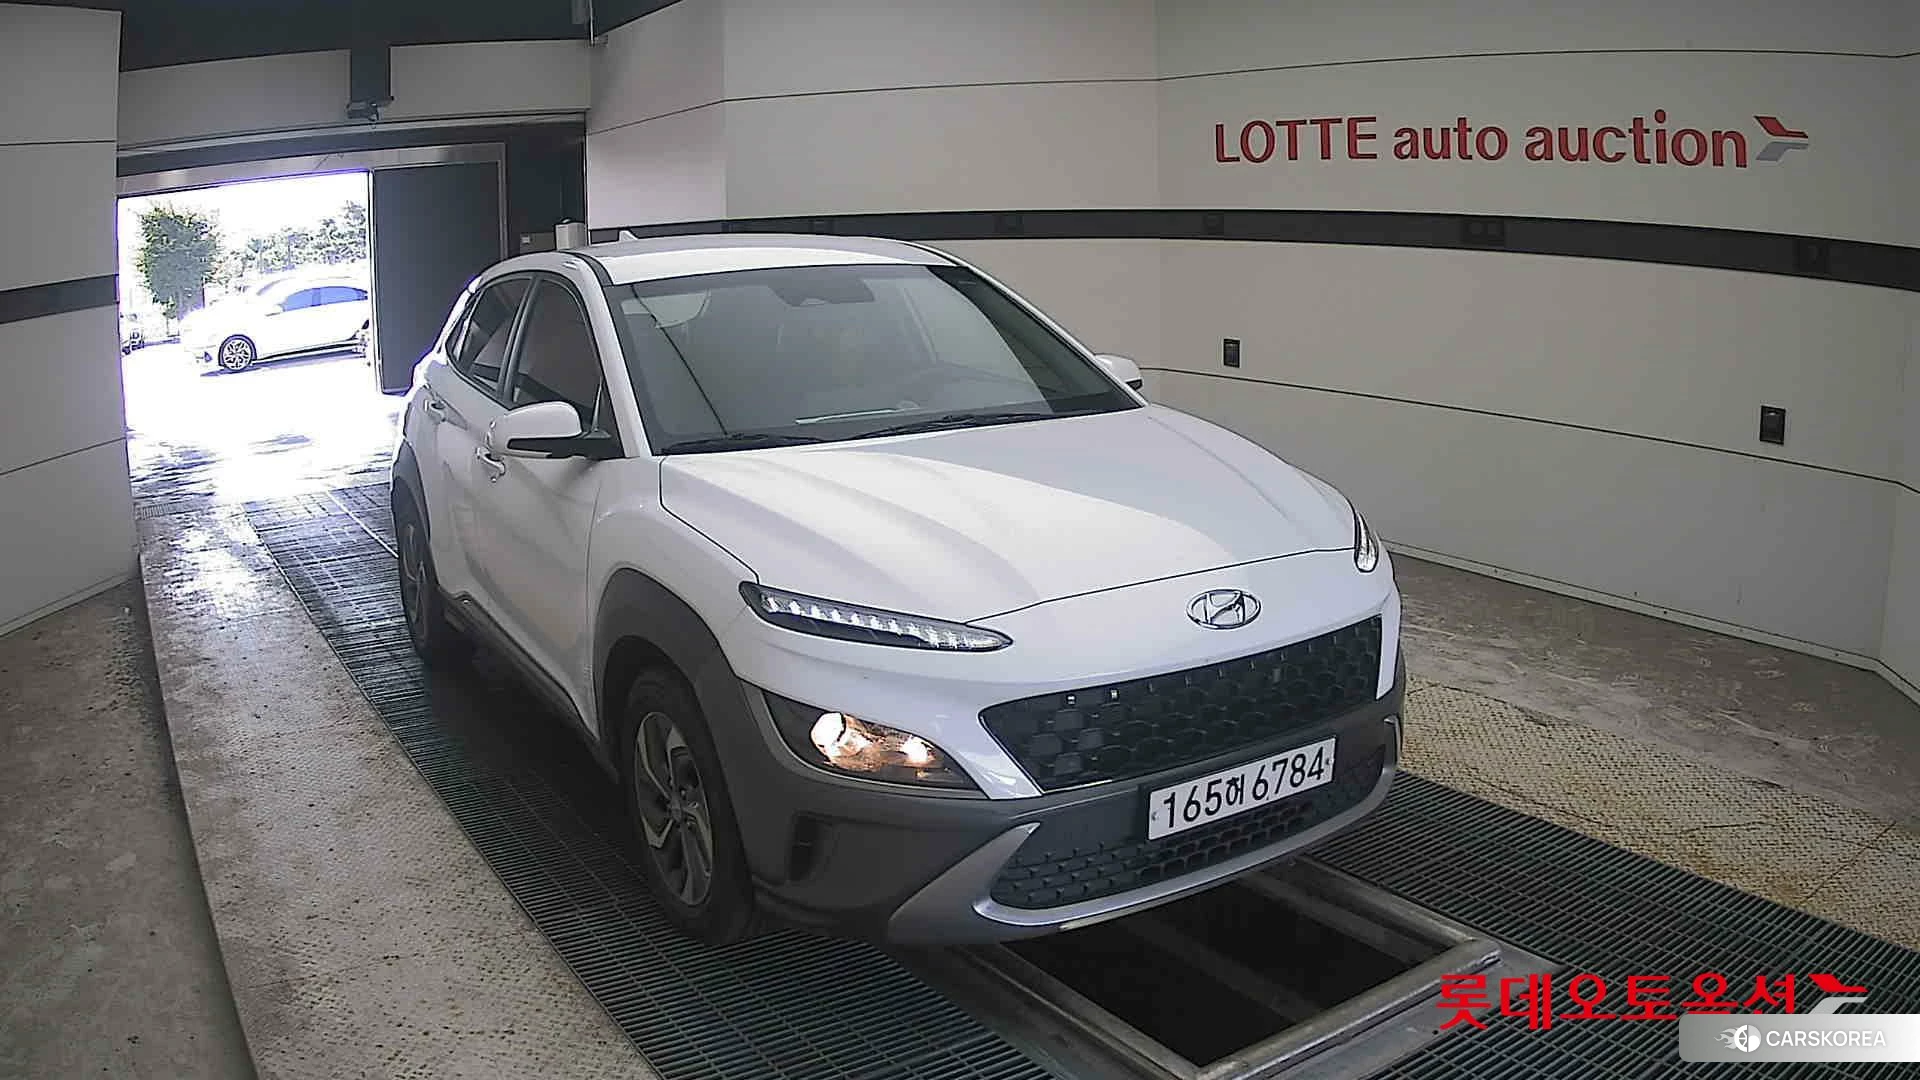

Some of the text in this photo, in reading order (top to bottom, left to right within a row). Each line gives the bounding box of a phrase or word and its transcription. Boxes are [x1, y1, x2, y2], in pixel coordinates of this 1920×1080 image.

[1215, 109, 1748, 168] LOTTE auto auction
